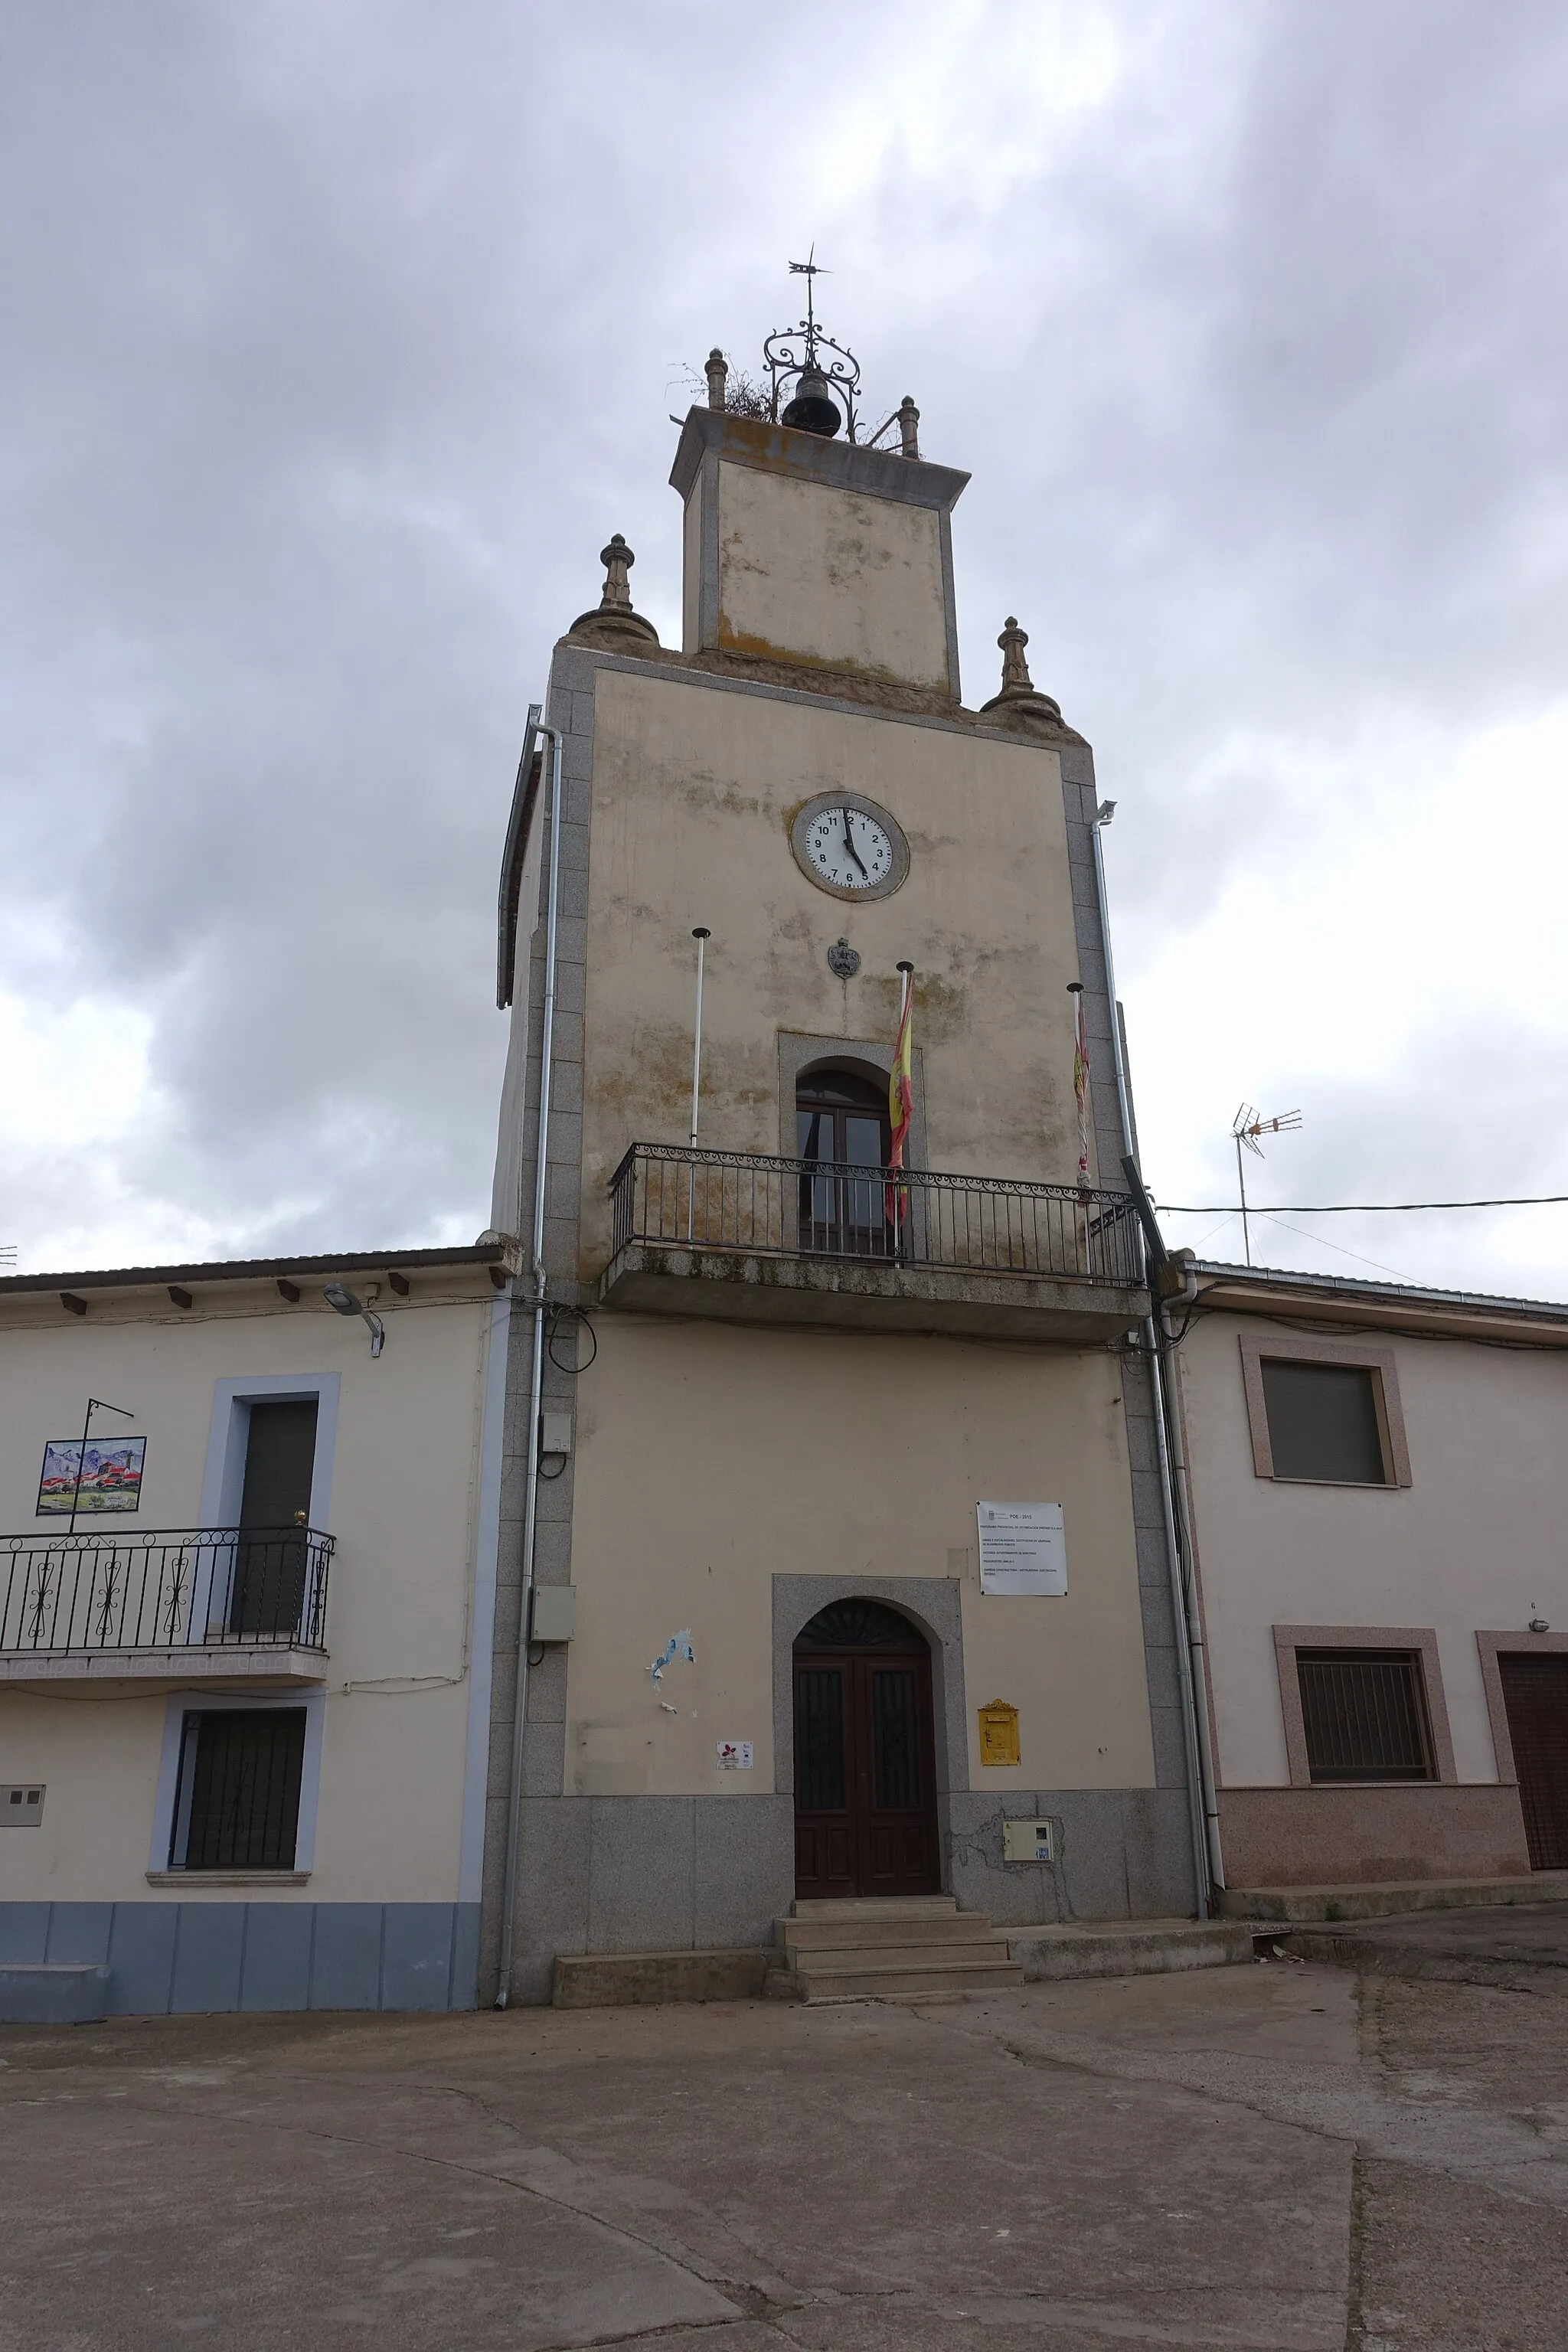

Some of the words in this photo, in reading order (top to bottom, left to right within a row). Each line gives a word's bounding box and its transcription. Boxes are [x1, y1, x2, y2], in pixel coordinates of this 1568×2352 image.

[828, 817, 838, 825] 11
[818, 826, 829, 835] 10
[861, 822, 866, 831] 1
[815, 839, 822, 848] 9
[872, 835, 879, 844] 2
[819, 854, 826, 862] 8
[877, 849, 884, 858] 3
[872, 862, 879, 871] 4
[831, 868, 838, 877] 7
[846, 873, 853, 882] 6
